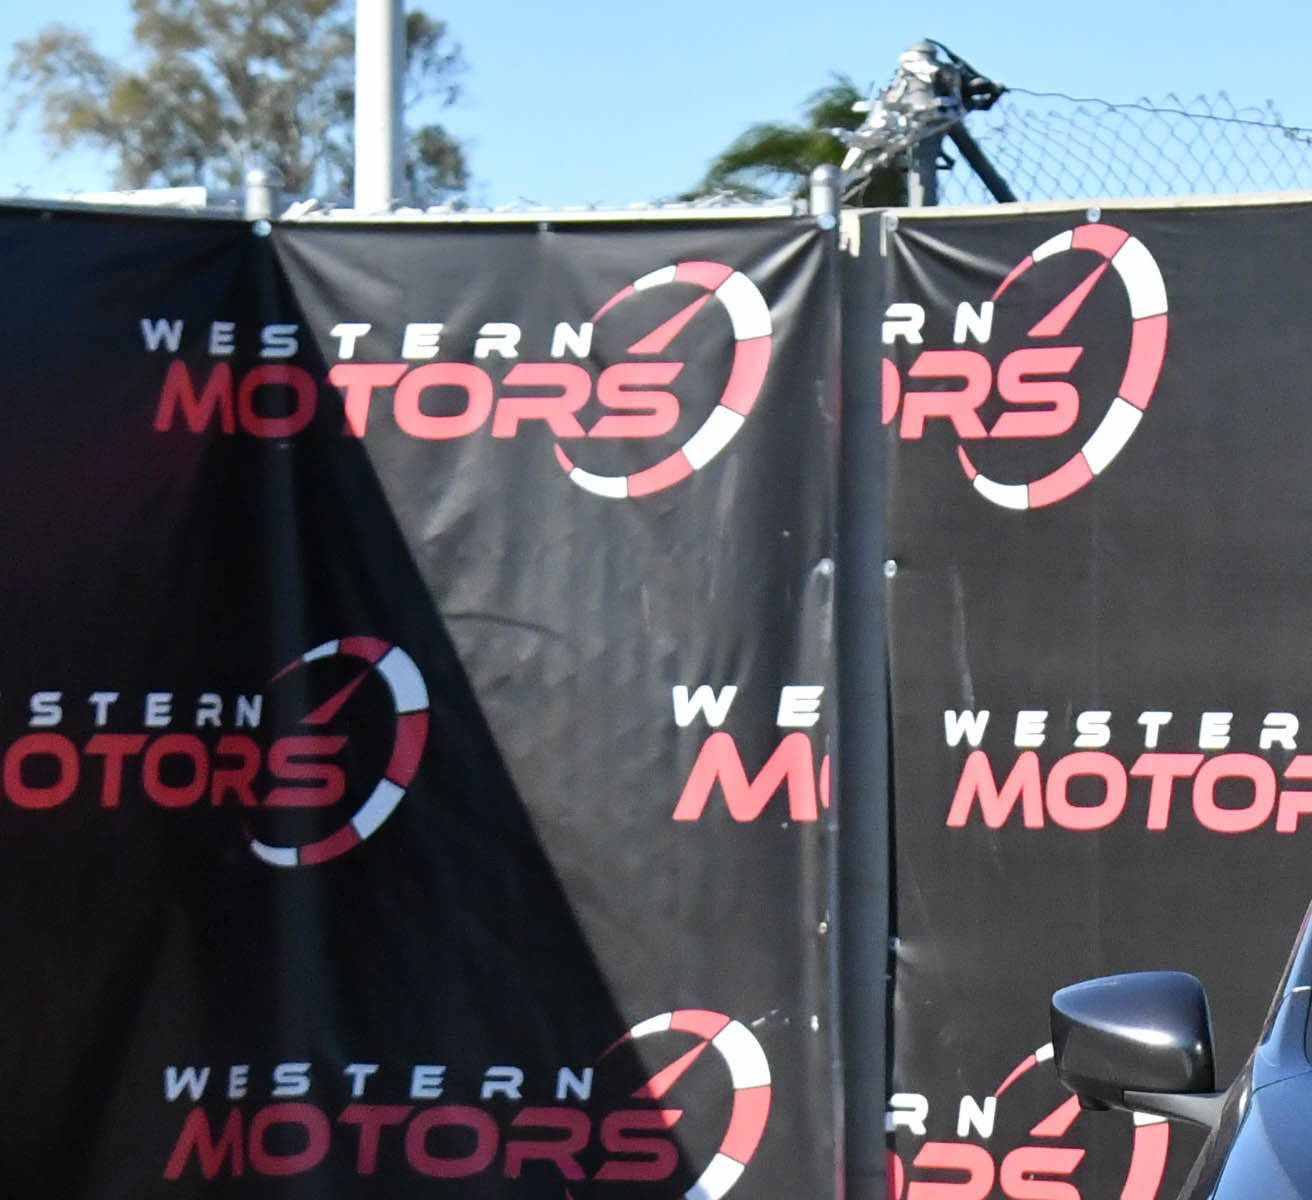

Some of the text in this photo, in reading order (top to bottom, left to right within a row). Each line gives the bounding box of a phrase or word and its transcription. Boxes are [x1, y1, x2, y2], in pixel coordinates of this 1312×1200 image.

[142, 317, 594, 359] WESTERN
[152, 360, 686, 441] MOTORS
[672, 730, 831, 823] M
[165, 1062, 594, 1102] WESTERN
[164, 1104, 684, 1182] MOTORS
